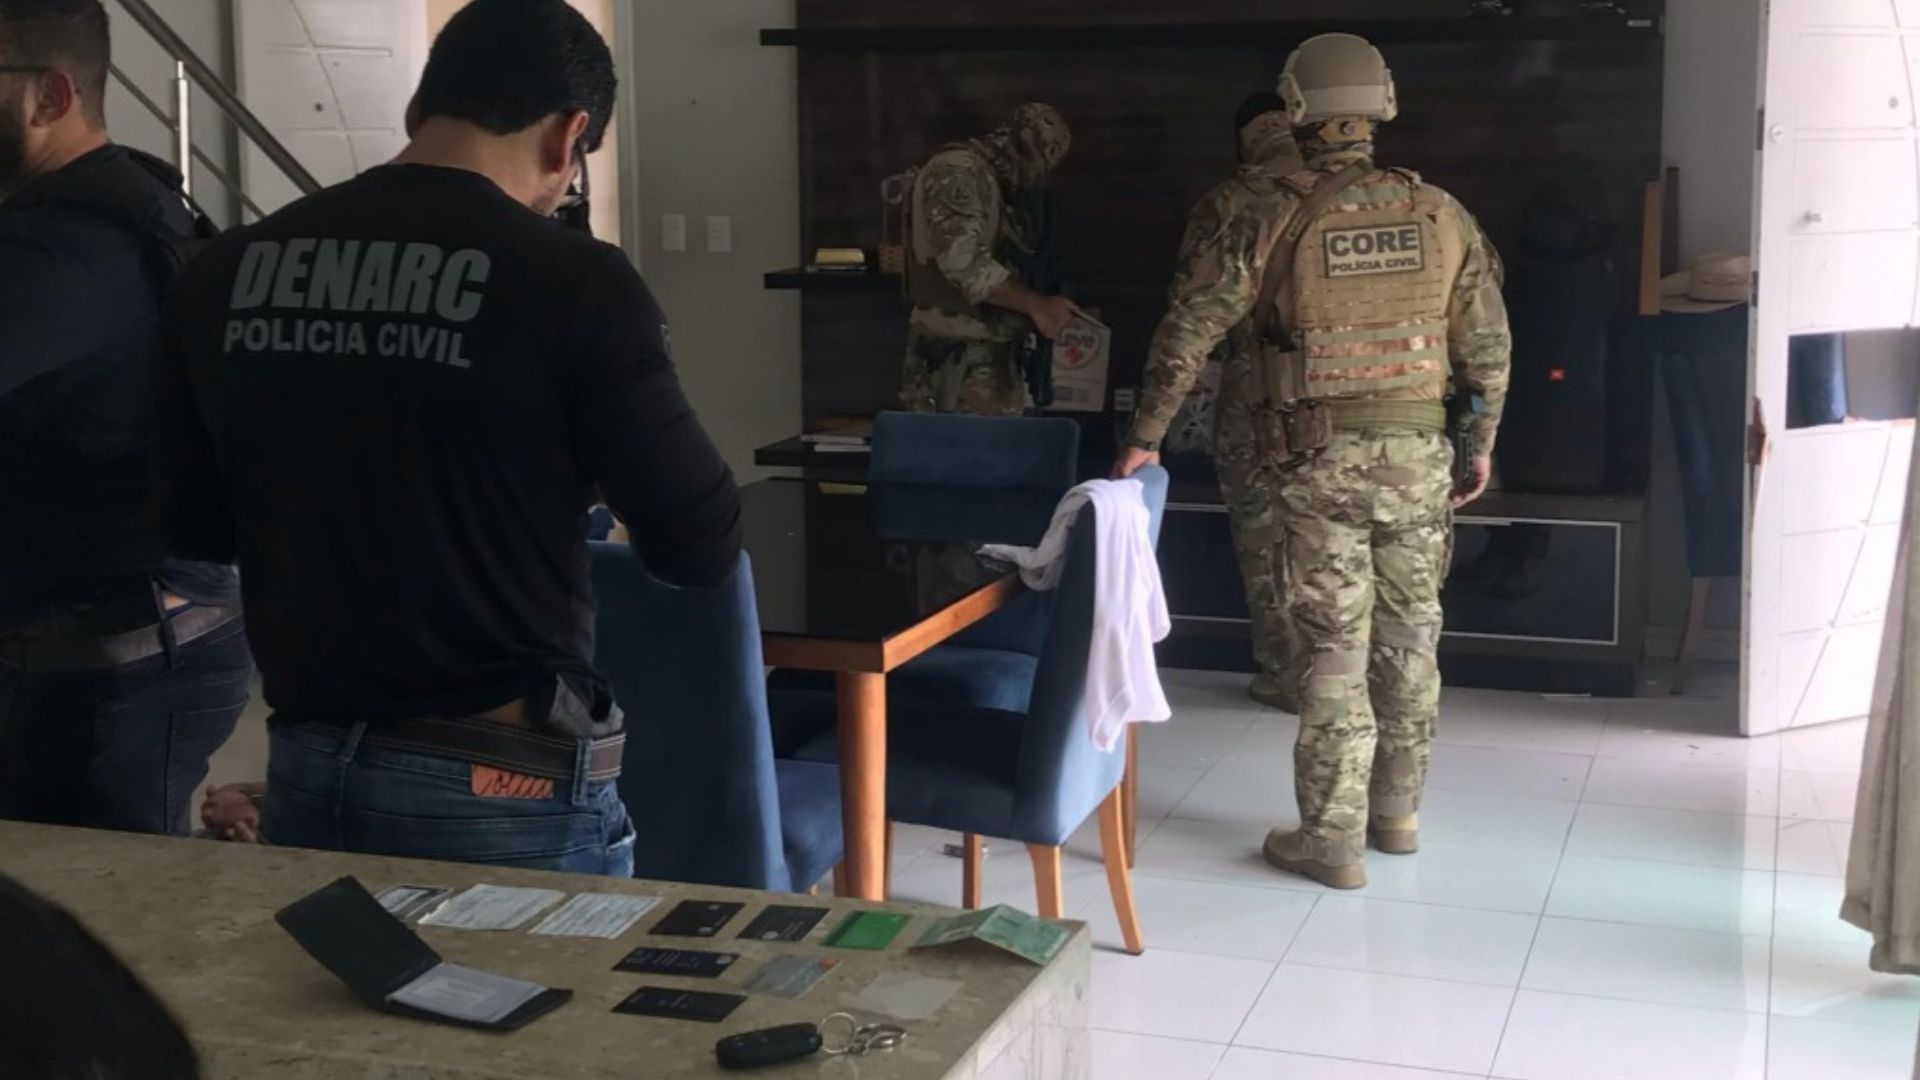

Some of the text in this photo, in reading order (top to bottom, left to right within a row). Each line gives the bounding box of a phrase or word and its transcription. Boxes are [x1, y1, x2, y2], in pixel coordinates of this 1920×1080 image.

[1329, 229, 1418, 257] CORE
[1385, 257, 1418, 268] CIVIL
[229, 238, 491, 322] DENARC
[223, 317, 472, 369] POLICIA CIVIL
